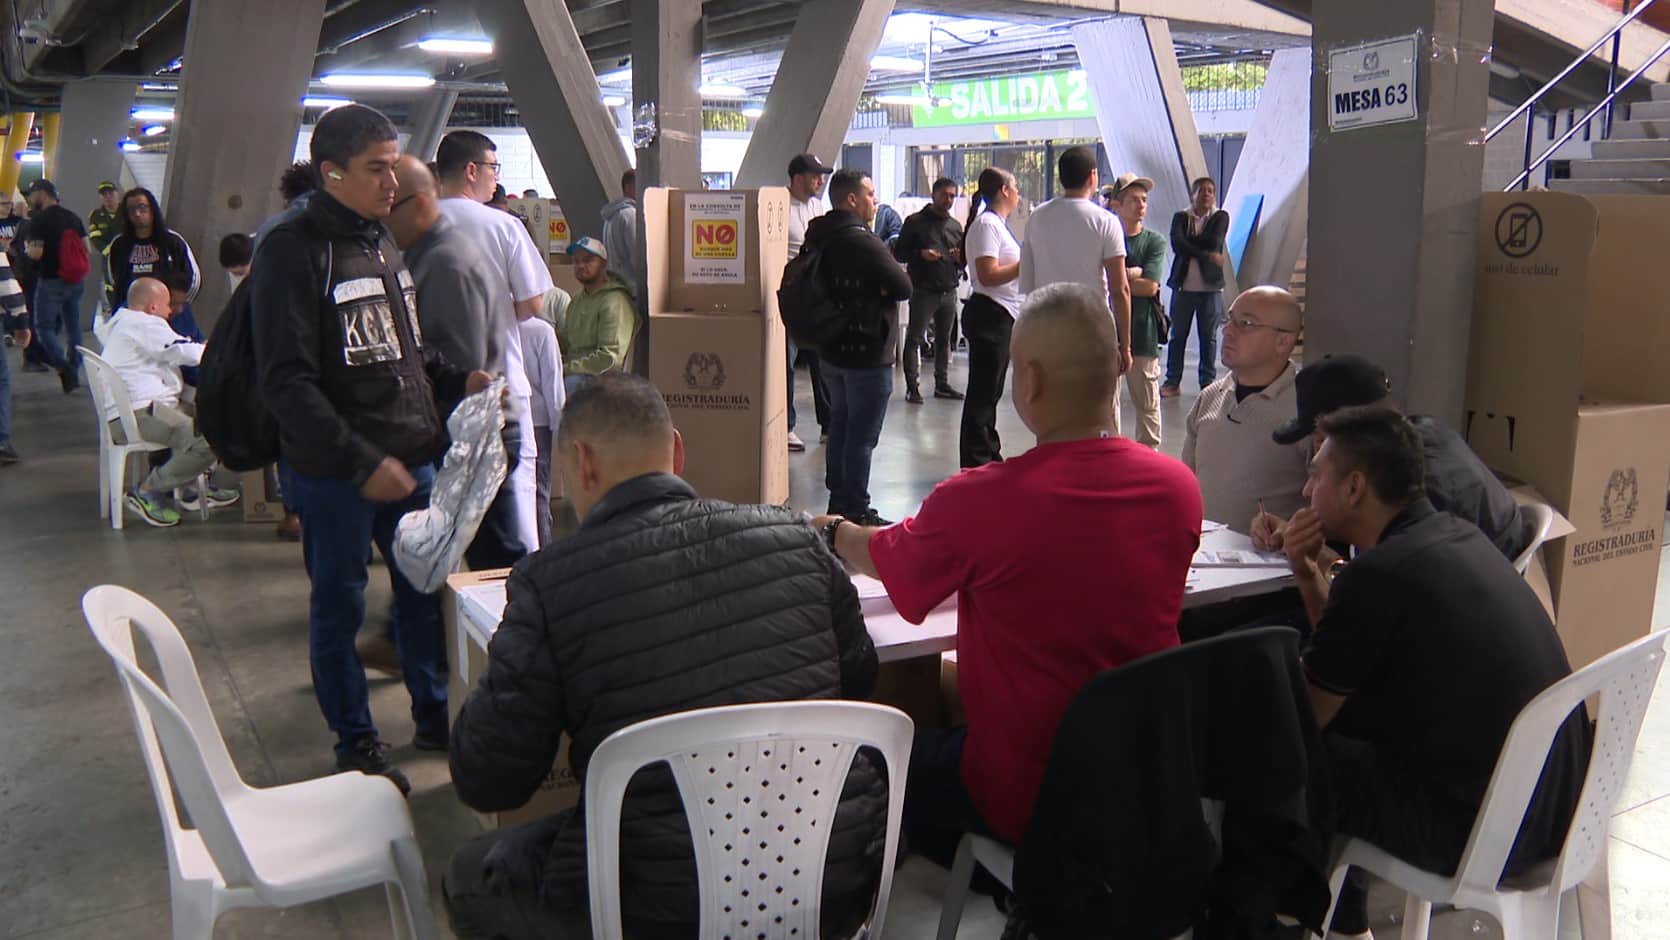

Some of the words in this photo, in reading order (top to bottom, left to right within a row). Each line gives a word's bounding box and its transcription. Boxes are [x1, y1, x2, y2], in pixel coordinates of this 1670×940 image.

[951, 75, 1063, 119] SALIDA
[1066, 69, 1088, 112] 2
[1335, 87, 1381, 114] MESA
[1385, 83, 1408, 106] 63
[696, 224, 735, 245] NO
